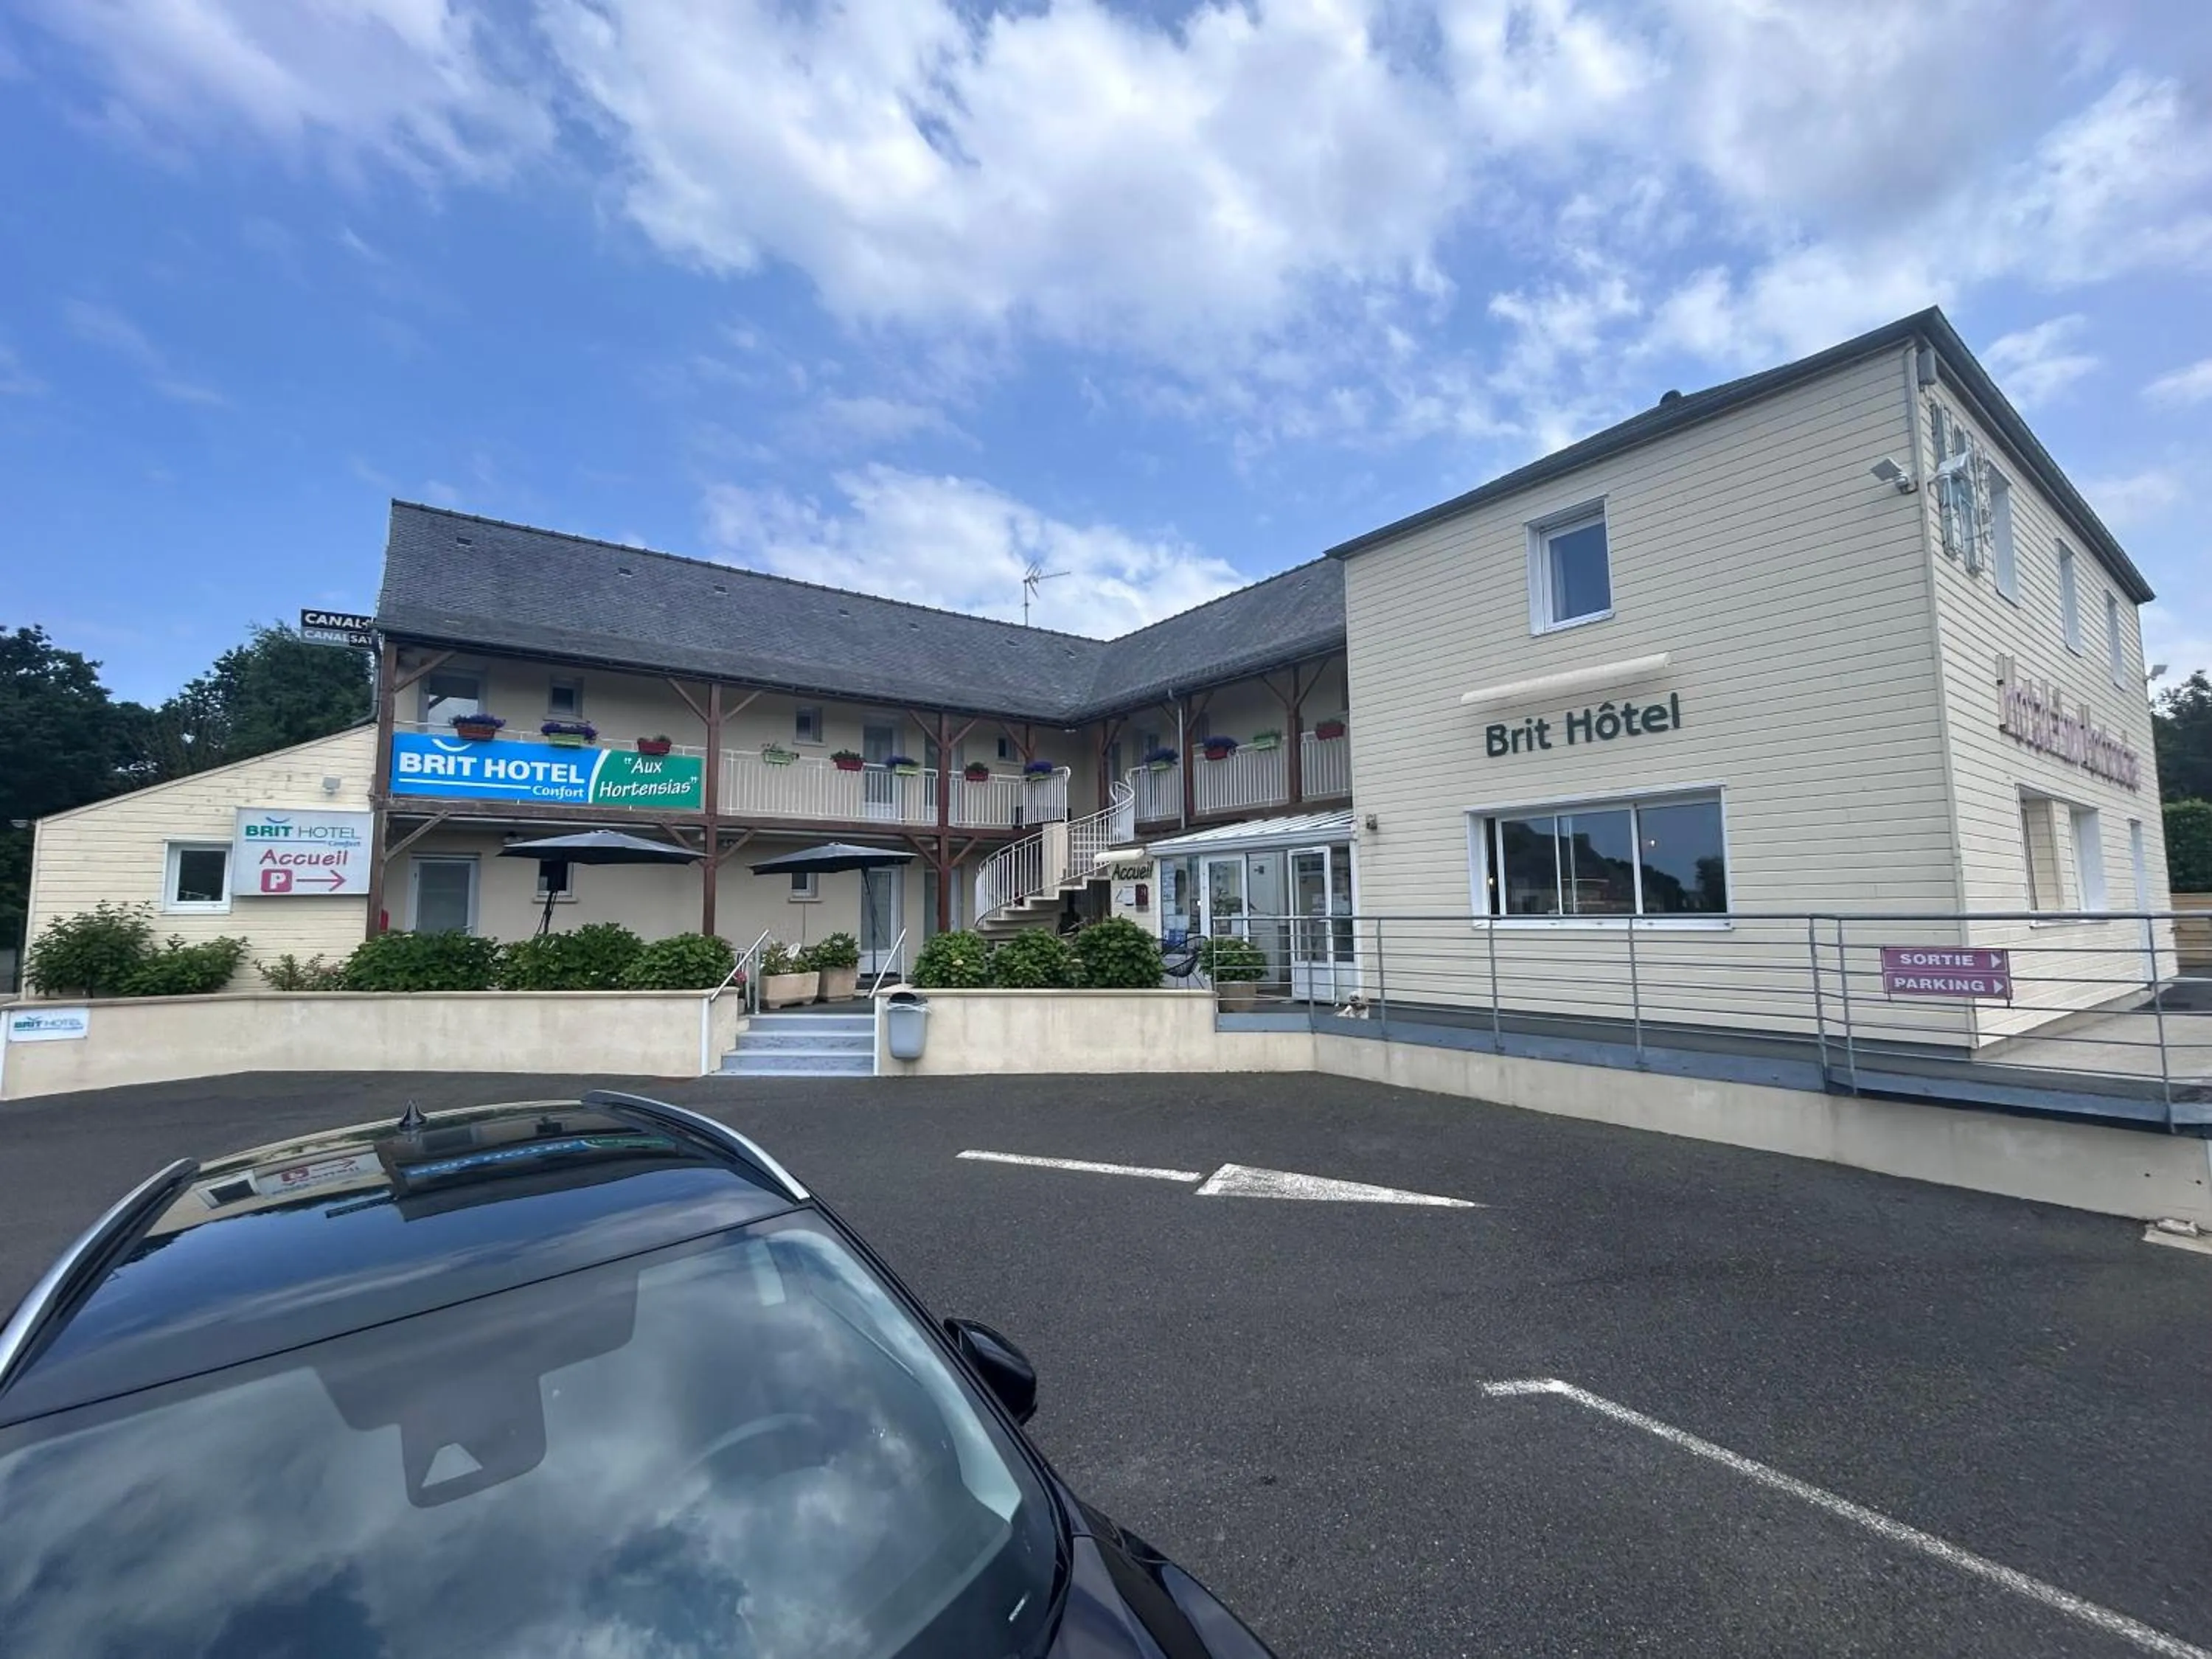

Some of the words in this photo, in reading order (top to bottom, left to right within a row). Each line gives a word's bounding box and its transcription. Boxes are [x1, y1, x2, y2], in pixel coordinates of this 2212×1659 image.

[1486, 717, 1552, 757] Brit
[1566, 692, 1680, 745] Hôtel
[399, 751, 477, 776] BRIT
[484, 758, 586, 784] HOTEL
[532, 785, 584, 800] Confort
[245, 825, 293, 837] BRIT
[298, 825, 362, 840] HOTEL
[259, 849, 349, 866] Accueil
[1111, 860, 1154, 881] Accueil
[1899, 953, 1975, 967] SORTIE
[1893, 977, 1986, 992] PARKING
